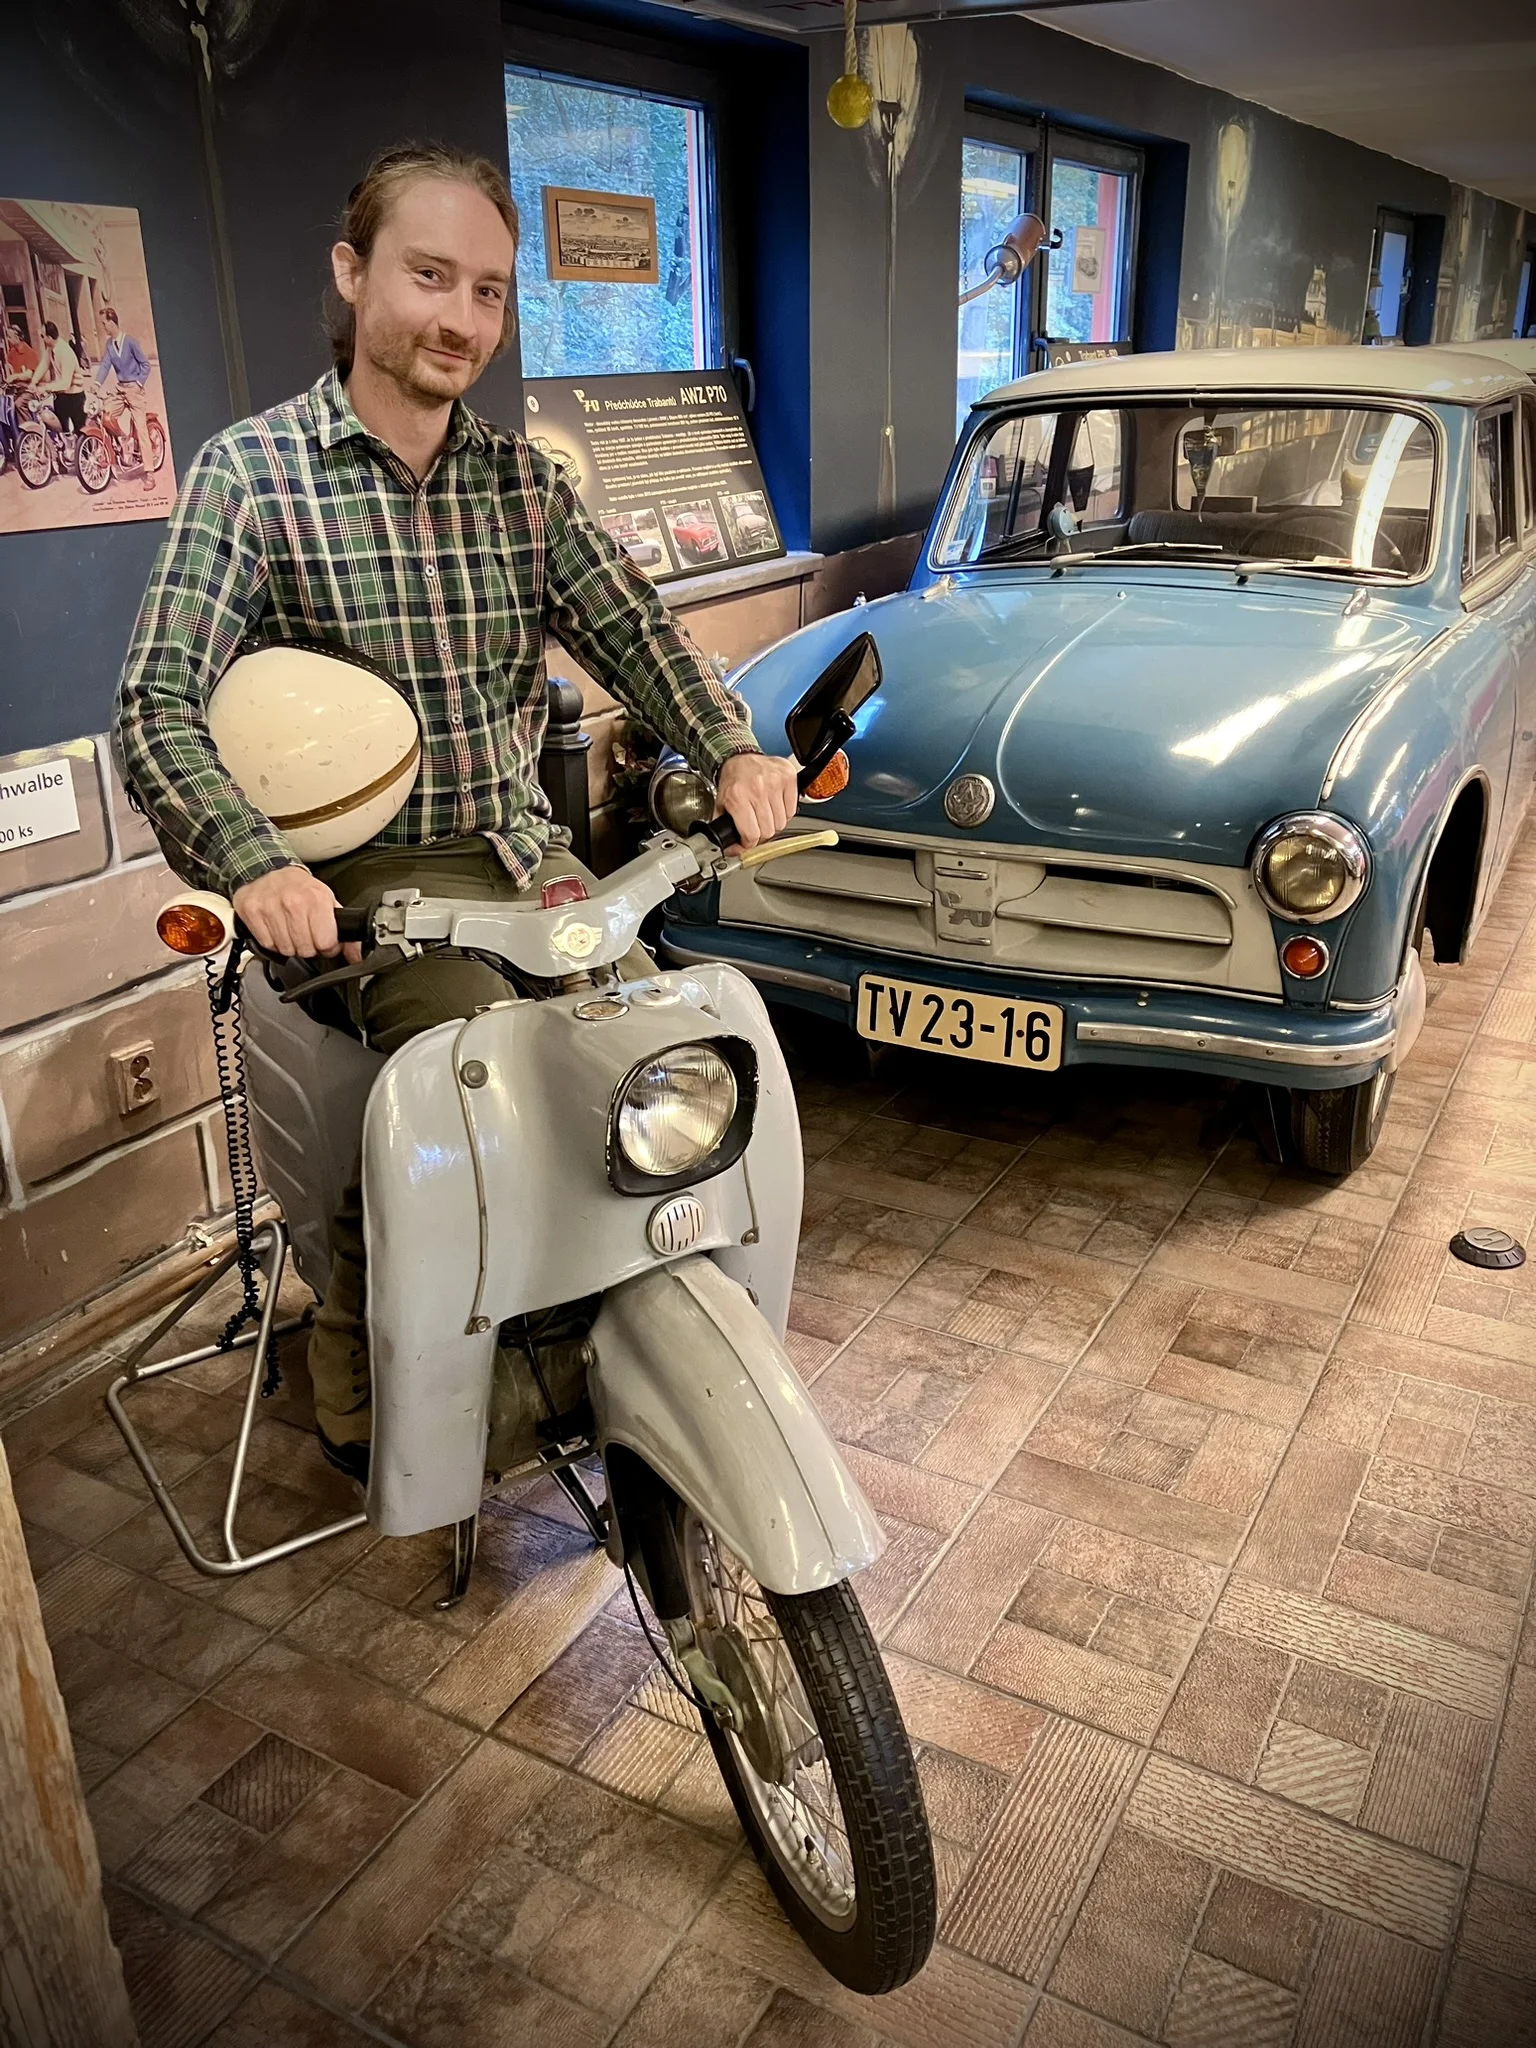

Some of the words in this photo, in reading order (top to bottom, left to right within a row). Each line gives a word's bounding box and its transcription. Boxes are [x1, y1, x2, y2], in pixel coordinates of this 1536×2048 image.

[679, 386, 707, 406] AWZ
[705, 385, 728, 404] P70
[18, 825, 34, 839] ks
